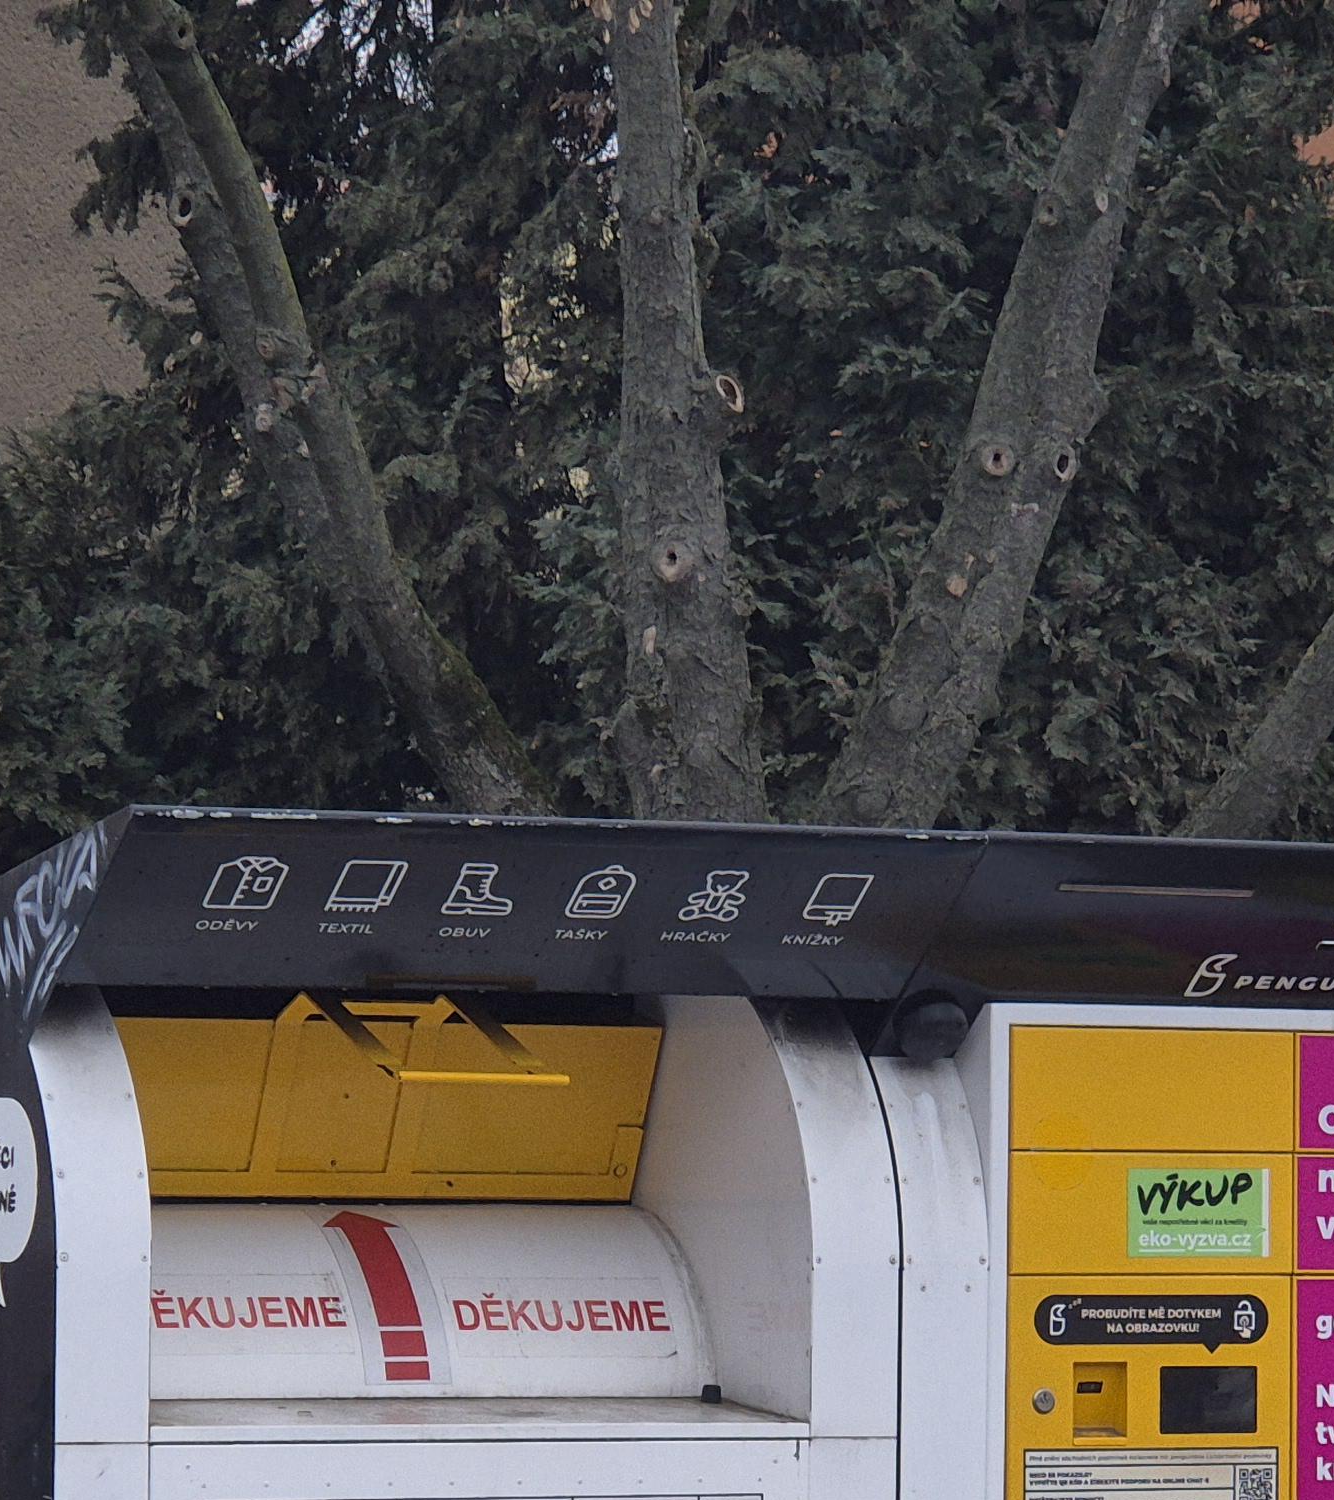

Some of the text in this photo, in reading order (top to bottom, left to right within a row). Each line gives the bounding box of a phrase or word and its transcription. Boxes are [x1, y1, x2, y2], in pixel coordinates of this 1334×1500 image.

[194, 918, 259, 934] ODĚVY
[317, 922, 375, 936] TEXTIL
[438, 925, 492, 940] OBUV
[554, 927, 609, 942] TAŠKY
[659, 929, 731, 944] HRAČKY
[781, 932, 845, 947] KNÍŽKY
[1137, 1172, 1253, 1216] VÝKUP
[1138, 1230, 1252, 1251] eko-vyzva.cz
[151, 1289, 348, 1329] ĚKUJEME
[454, 1293, 670, 1333] DĚKUJEME
[1167, 1308, 1222, 1320] DOTYKEM
[1106, 1322, 1200, 1334] NA OBRAZOVKU!
